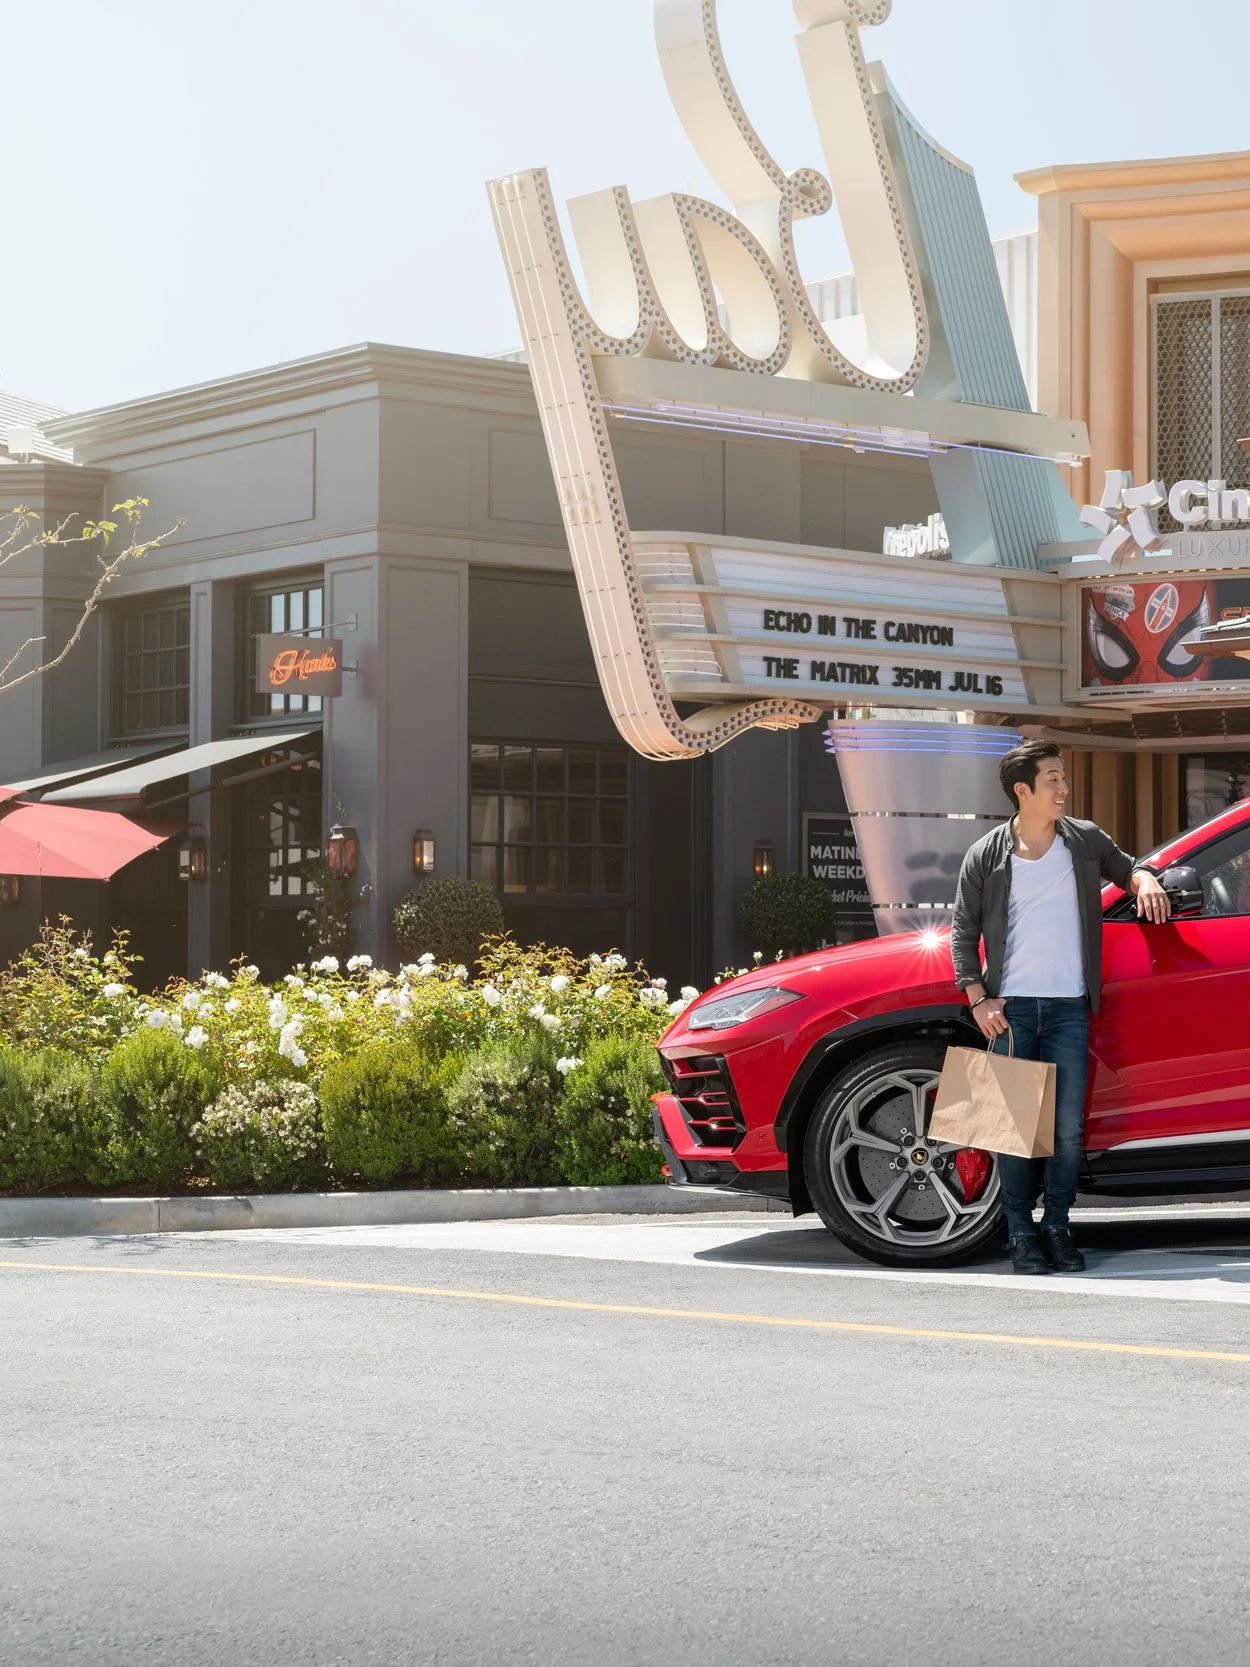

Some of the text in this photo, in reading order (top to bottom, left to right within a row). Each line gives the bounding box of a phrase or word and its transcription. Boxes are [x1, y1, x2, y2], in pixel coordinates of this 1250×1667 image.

[763, 609, 954, 647] ECHO IN THE CANYON
[1105, 604, 1126, 618] VENICE
[269, 646, 337, 685] Hank's
[763, 656, 799, 679] THE
[811, 660, 880, 685] MATRIX
[892, 667, 942, 690] 35MM
